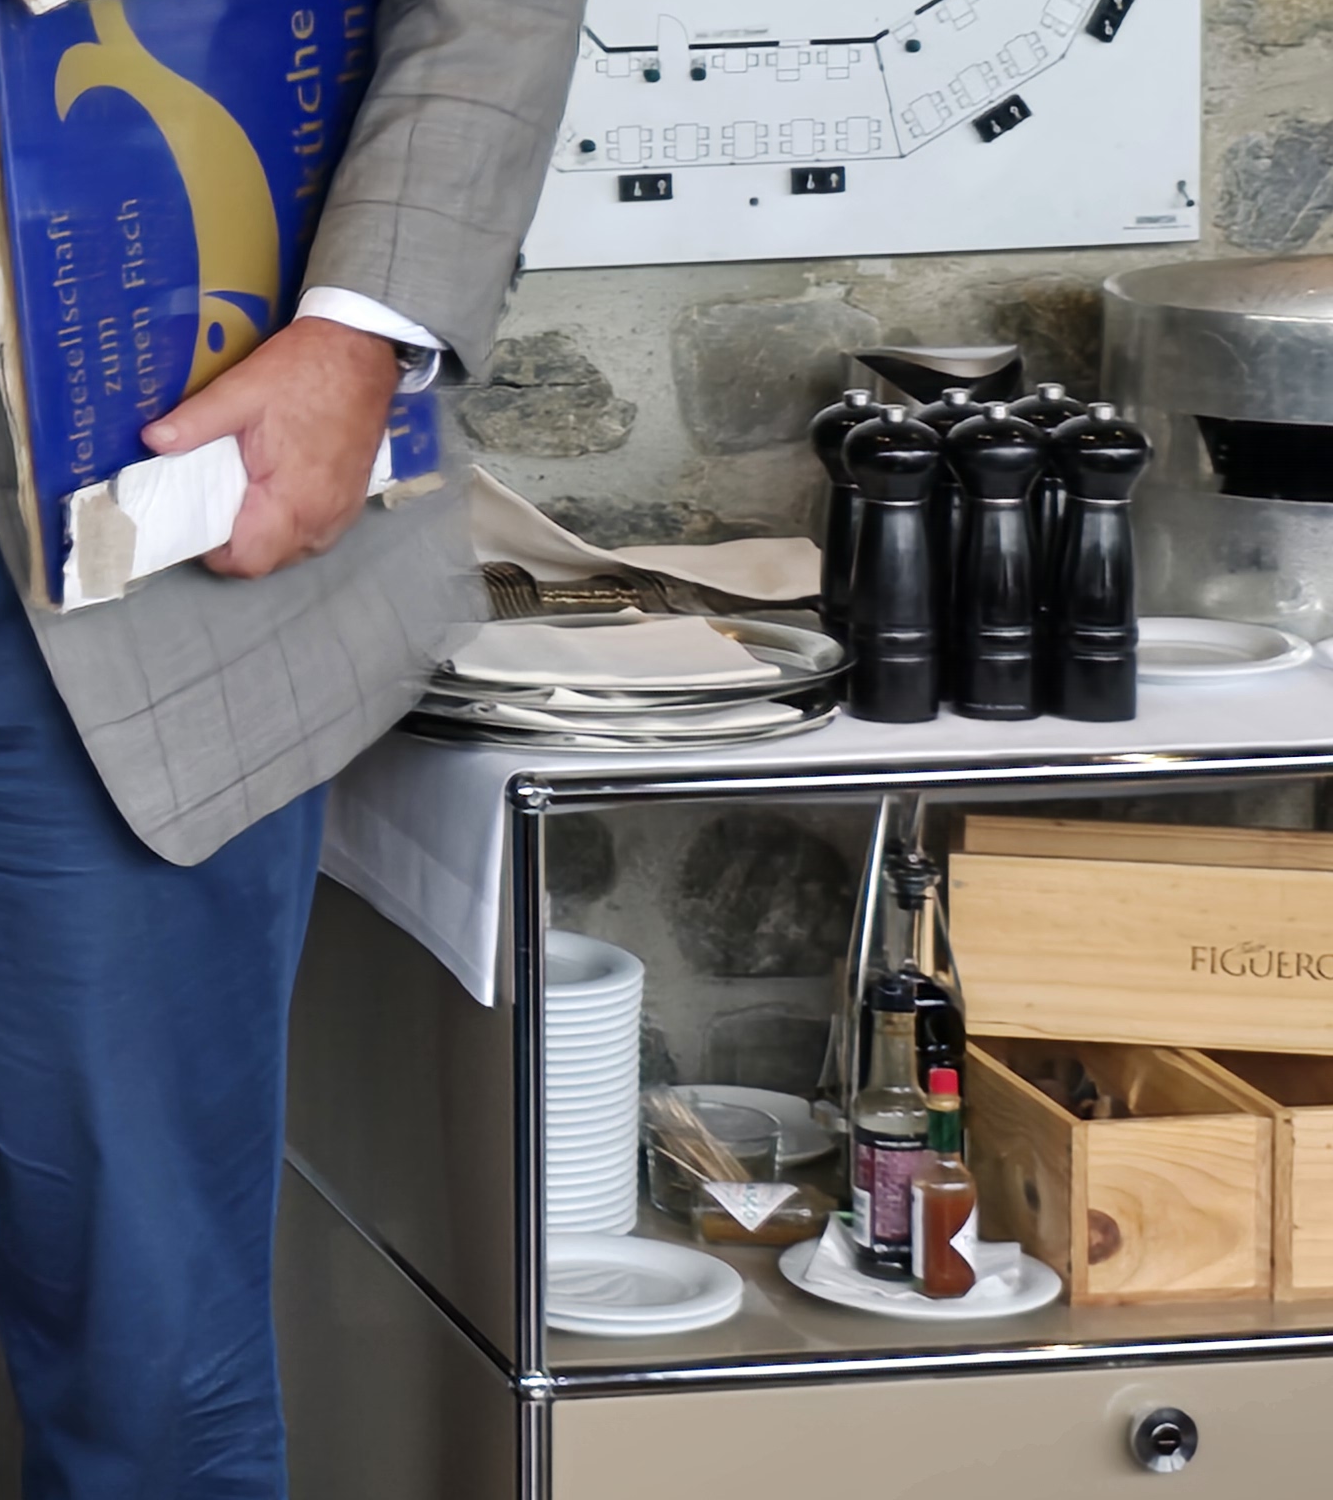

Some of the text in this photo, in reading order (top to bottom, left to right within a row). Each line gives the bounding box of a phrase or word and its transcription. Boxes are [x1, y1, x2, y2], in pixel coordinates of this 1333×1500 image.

[116, 198, 147, 290] Fisch
[47, 209, 96, 486] felgesellschaft
[98, 316, 123, 396] zum
